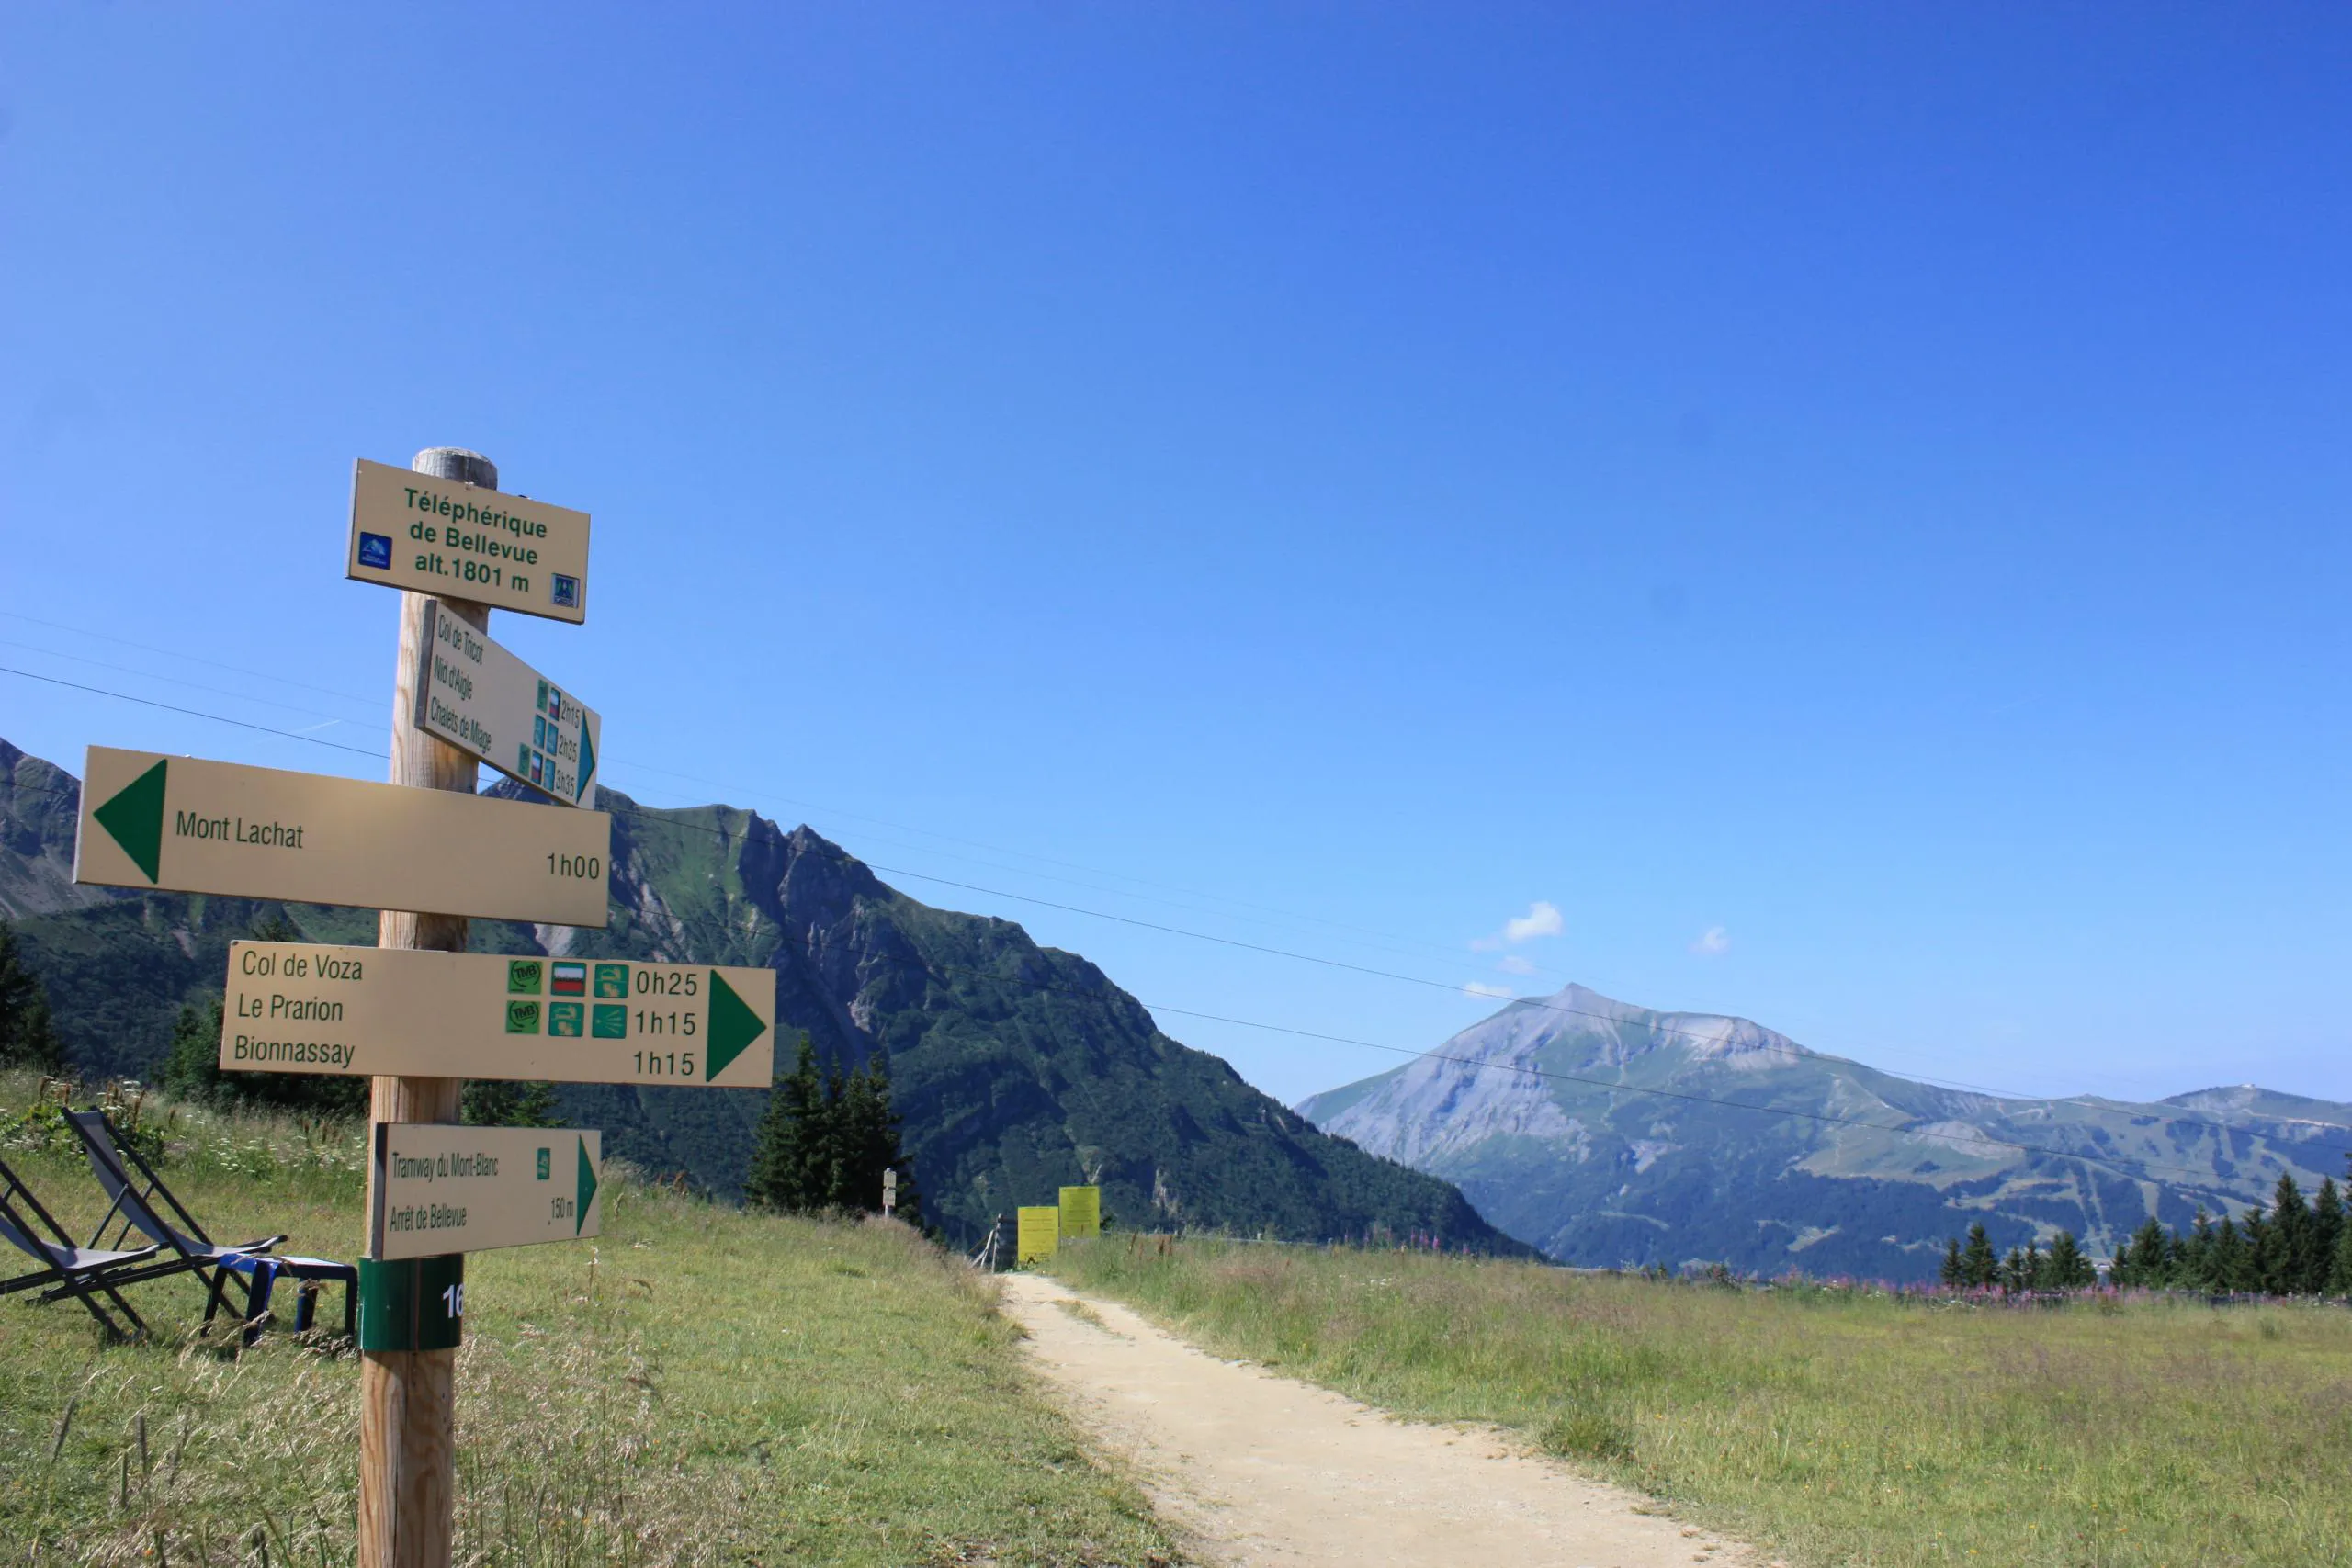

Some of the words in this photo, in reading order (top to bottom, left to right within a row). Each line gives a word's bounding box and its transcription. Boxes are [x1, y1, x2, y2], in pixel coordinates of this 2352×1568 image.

[404, 487, 548, 538] Téléphérique
[410, 521, 437, 543] de
[446, 527, 537, 565] Bellevue
[512, 575, 529, 592] m
[438, 615, 452, 643] Col
[453, 626, 462, 650] de
[464, 631, 483, 666] Tricot
[434, 654, 448, 685] Nid
[448, 666, 473, 701] d'Aigle
[430, 696, 458, 734] Chalets
[459, 714, 469, 739] de
[470, 719, 492, 754] Miage
[561, 700, 580, 728] 2h15
[559, 734, 577, 763] 2h35
[556, 769, 575, 797] 3h35
[176, 810, 230, 842] Mont
[236, 820, 304, 850] Lachat
[547, 853, 600, 880] 1h00
[243, 950, 276, 976] Col
[284, 953, 308, 977] de
[315, 954, 363, 980] Voza
[514, 965, 537, 979] TMB
[636, 970, 697, 996] 0h25
[238, 993, 263, 1018] Le
[270, 994, 343, 1021] Prarion
[513, 1005, 536, 1020] TMB
[635, 1011, 695, 1036] 1h15
[234, 1035, 356, 1068] Bionnassay
[634, 1051, 695, 1076] 1h15
[392, 1151, 435, 1183] Tramway
[437, 1152, 448, 1177] du
[451, 1153, 499, 1177] Mont-Blanc
[390, 1205, 414, 1232] Arrêt
[416, 1205, 428, 1229] de
[430, 1203, 468, 1228] Bellevue
[551, 1197, 565, 1219] 150
[566, 1200, 574, 1218] m
